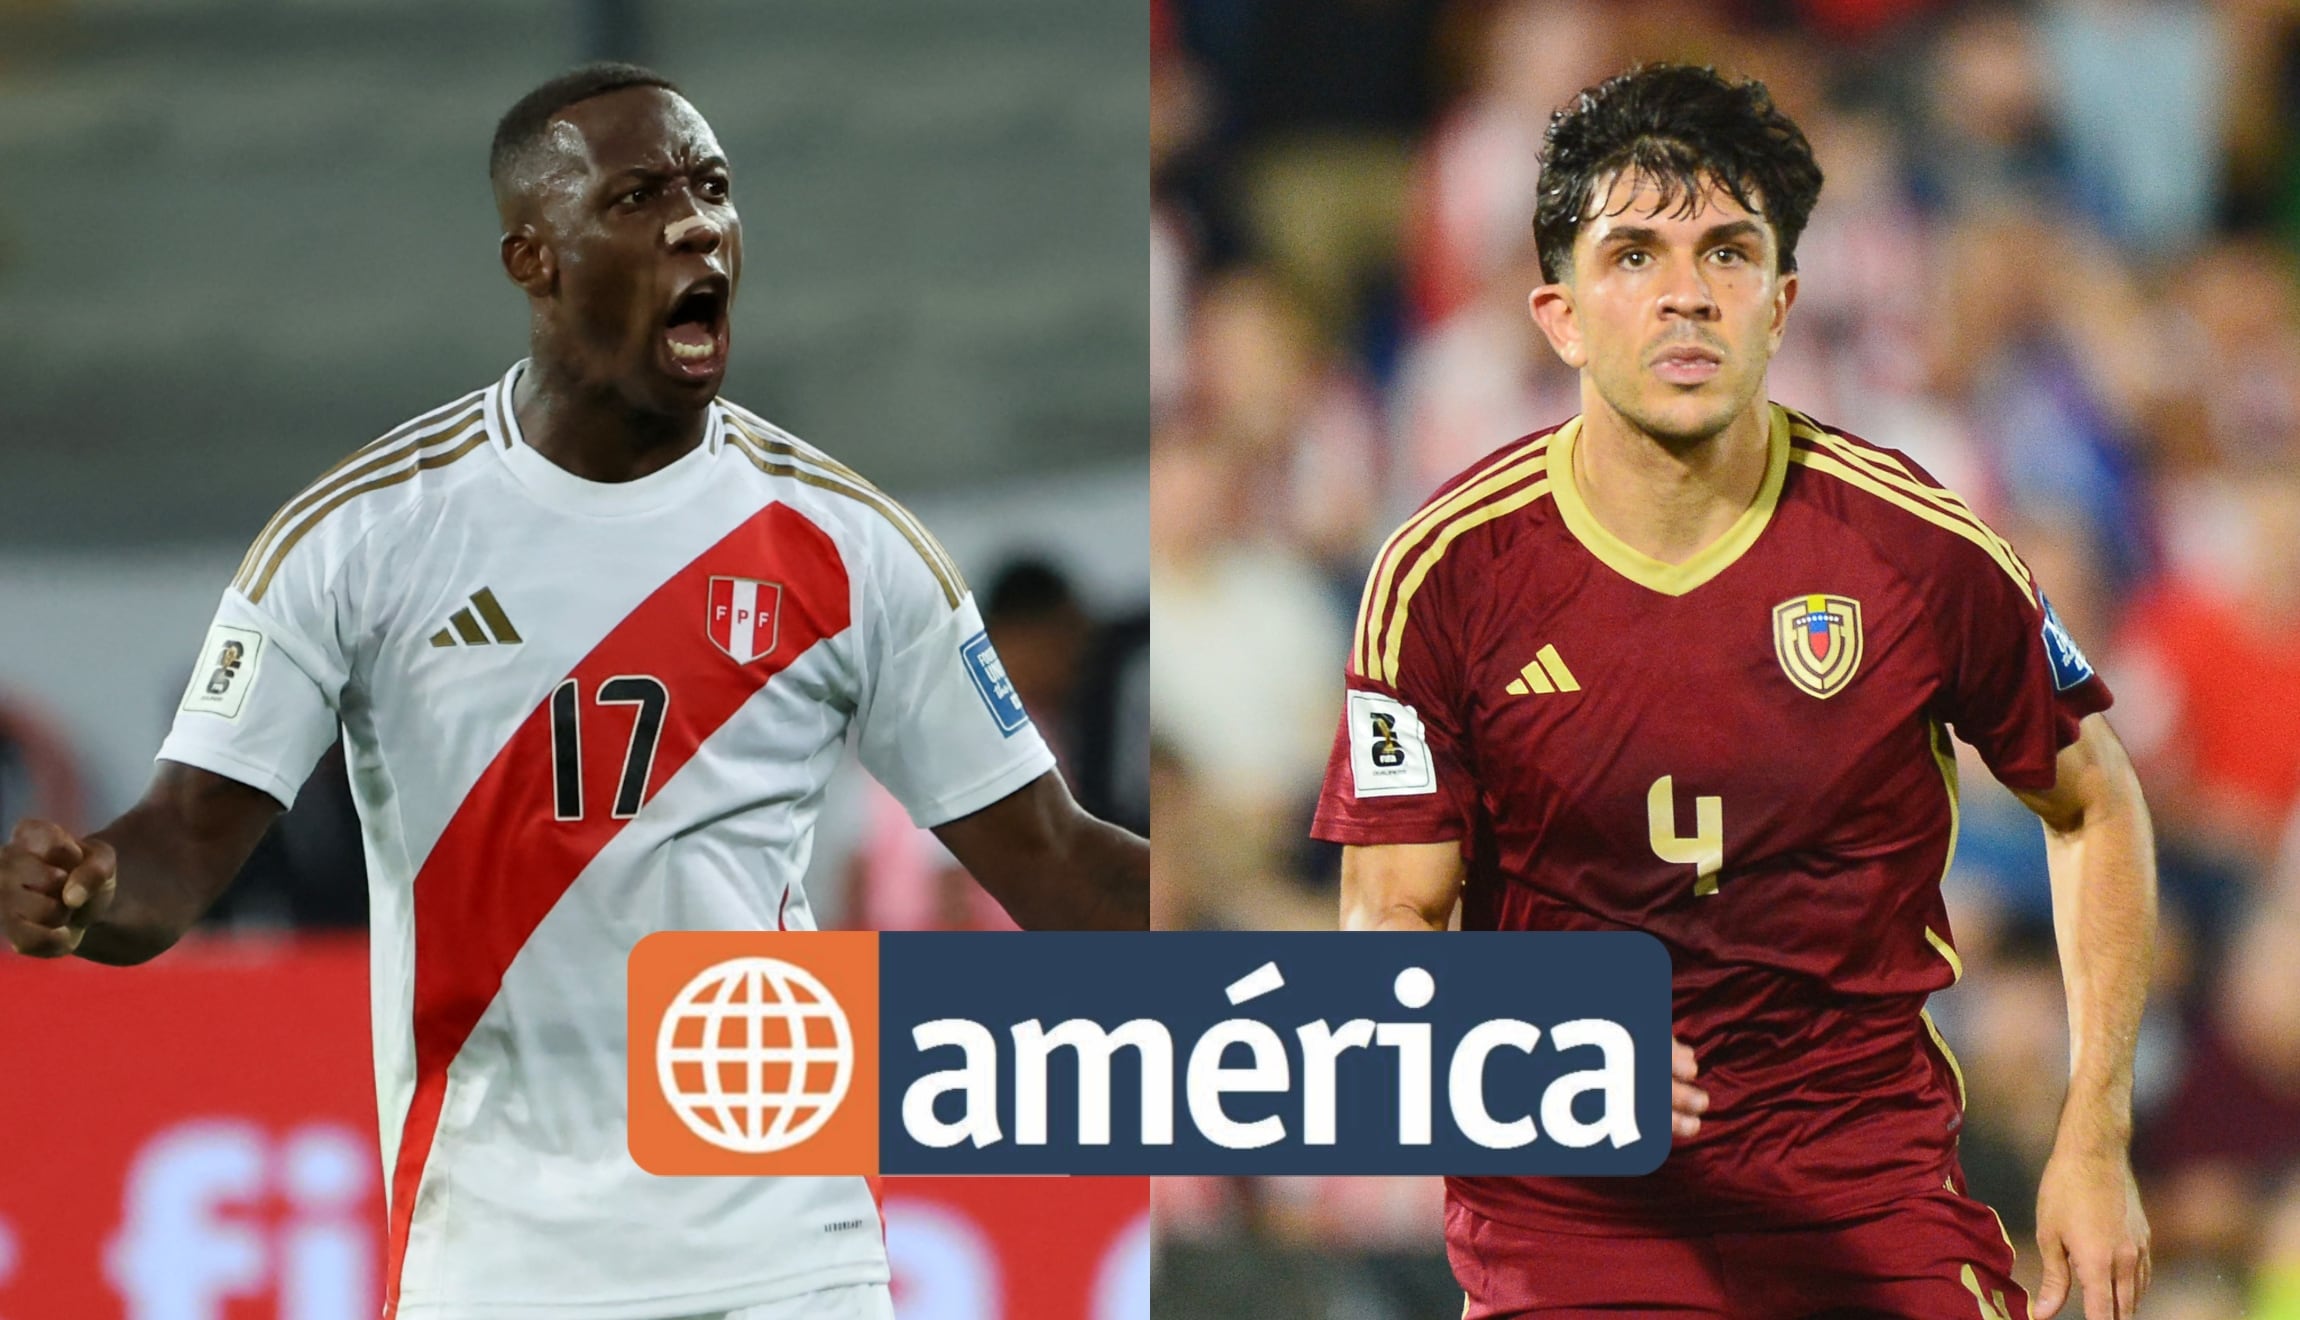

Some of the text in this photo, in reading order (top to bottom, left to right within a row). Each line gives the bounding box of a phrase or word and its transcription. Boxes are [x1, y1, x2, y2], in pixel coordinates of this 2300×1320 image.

[716, 605, 769, 628] FPF
[550, 674, 670, 822] 17
[1647, 774, 1723, 897] 4
